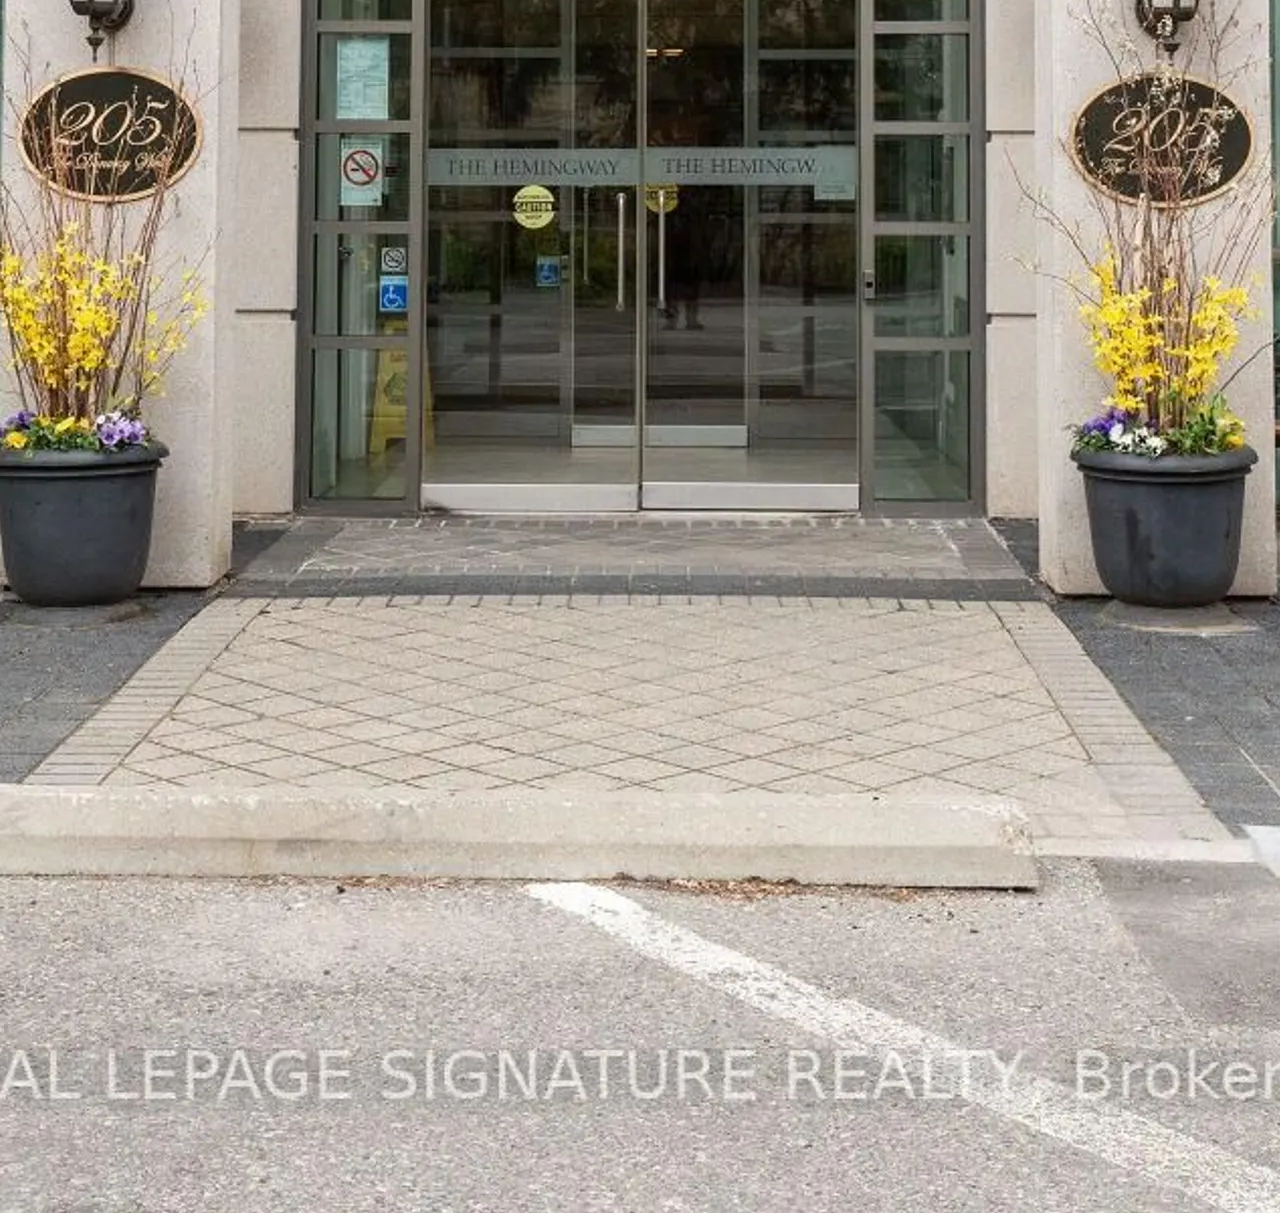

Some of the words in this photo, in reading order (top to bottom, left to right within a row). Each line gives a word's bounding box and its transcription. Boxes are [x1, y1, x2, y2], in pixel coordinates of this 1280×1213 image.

[55, 99, 169, 146] 205
[1103, 107, 1227, 152] 205
[448, 159, 487, 176] THE
[494, 159, 619, 176] HEMINGWAY
[663, 158, 704, 174] THE
[711, 157, 818, 175] HEMINGW
